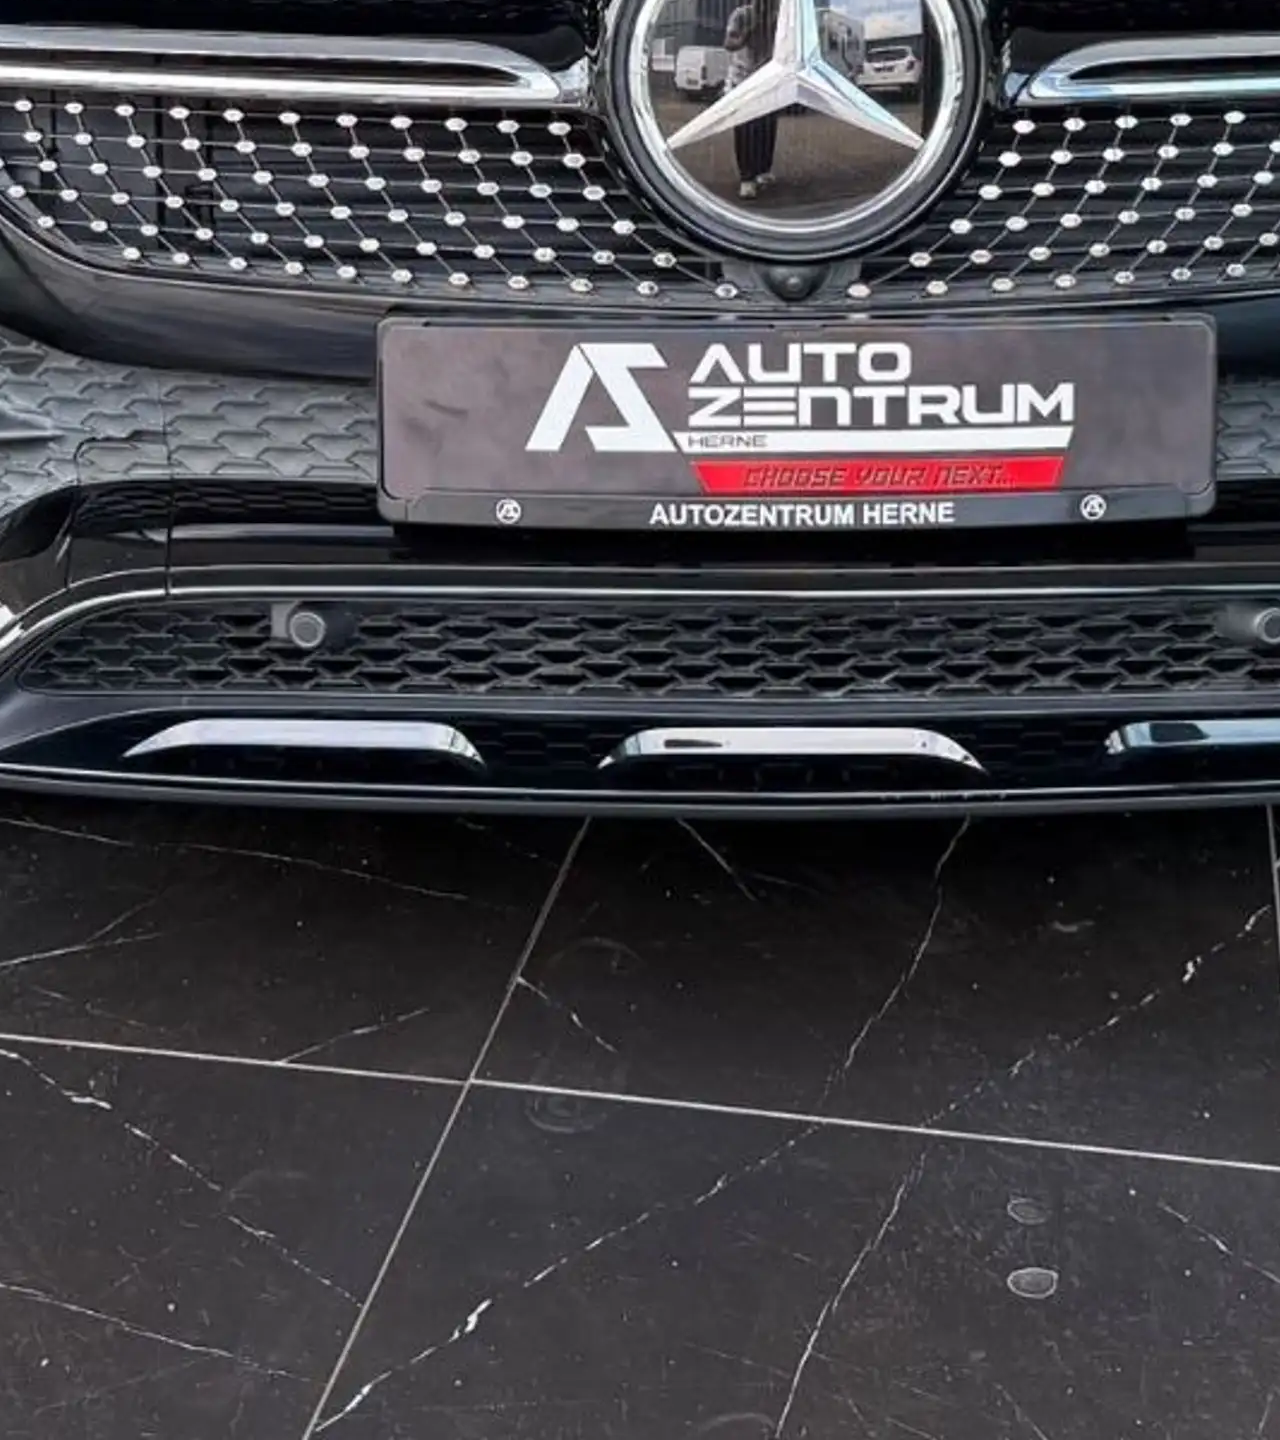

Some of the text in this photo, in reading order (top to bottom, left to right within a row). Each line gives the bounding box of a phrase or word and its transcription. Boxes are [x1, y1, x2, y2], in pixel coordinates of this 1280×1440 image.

[689, 342, 912, 384] AUTO
[687, 382, 1074, 427] ZENTRUM
[687, 434, 768, 449] HERNE
[744, 466, 845, 489] CHOOSE
[856, 465, 926, 487] YOUR
[649, 501, 956, 527] AUTOZENTRUM HERNE
